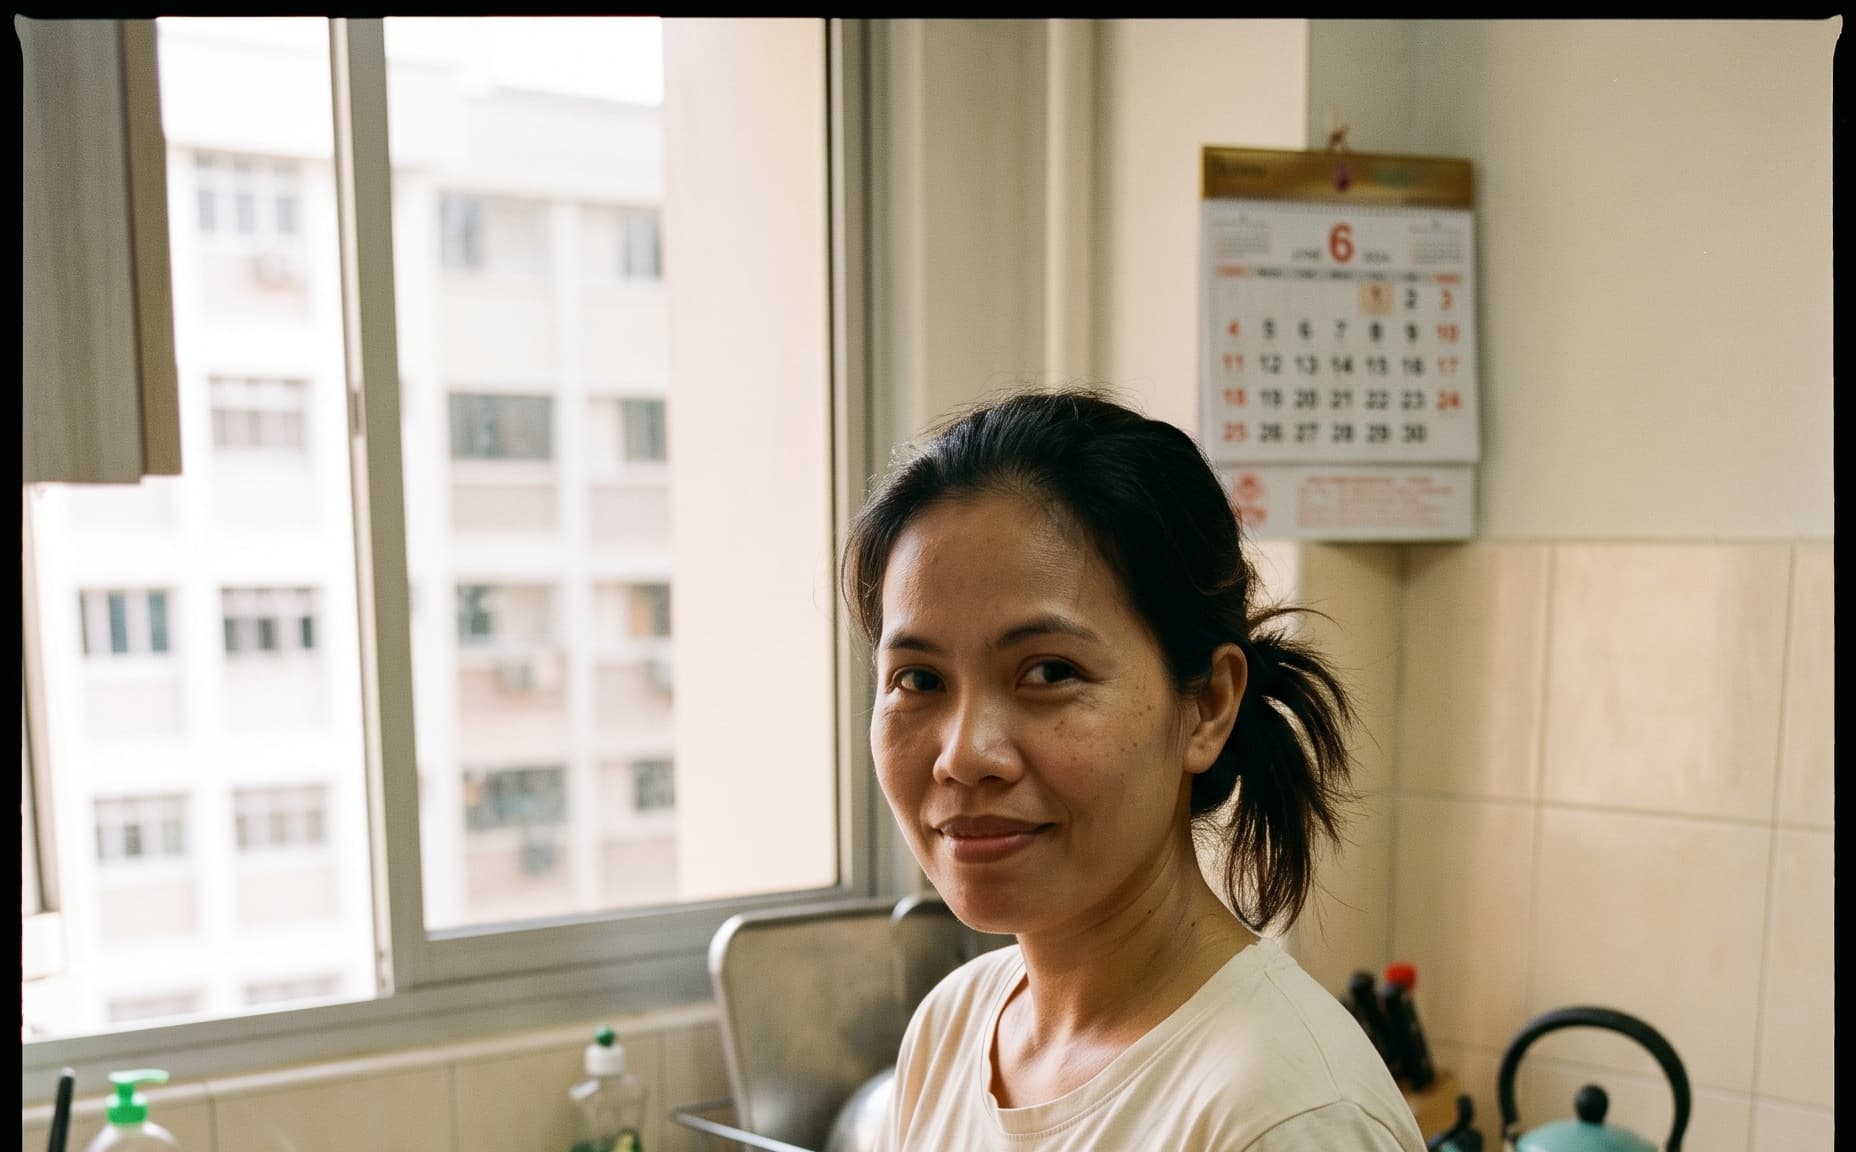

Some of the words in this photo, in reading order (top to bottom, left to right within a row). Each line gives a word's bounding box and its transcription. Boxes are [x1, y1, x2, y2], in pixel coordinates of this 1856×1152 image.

[1328, 221, 1355, 265] 6
[1370, 286, 1383, 308] 1
[1403, 287, 1418, 310] 2
[1226, 318, 1241, 338] 4
[1262, 317, 1276, 340] 5
[1297, 320, 1313, 341] 6
[1334, 318, 1349, 341] 7
[1405, 322, 1419, 343] 9
[1222, 352, 1245, 373] 11
[1258, 353, 1283, 375] 12
[1294, 354, 1321, 377] 13
[1329, 355, 1354, 376] 14
[1365, 355, 1389, 376] 15
[1402, 356, 1426, 377] 16
[1436, 355, 1460, 377] 17
[1260, 388, 1284, 408] 19
[1294, 388, 1319, 410] 20
[1329, 388, 1353, 411] 21
[1365, 389, 1390, 411] 22
[1400, 389, 1426, 412] 23
[1436, 391, 1462, 411] 24
[1259, 422, 1284, 443] 26
[1294, 421, 1319, 444] 27
[1332, 423, 1355, 443] 28
[1367, 423, 1392, 444] 29
[1403, 423, 1428, 444] 30
